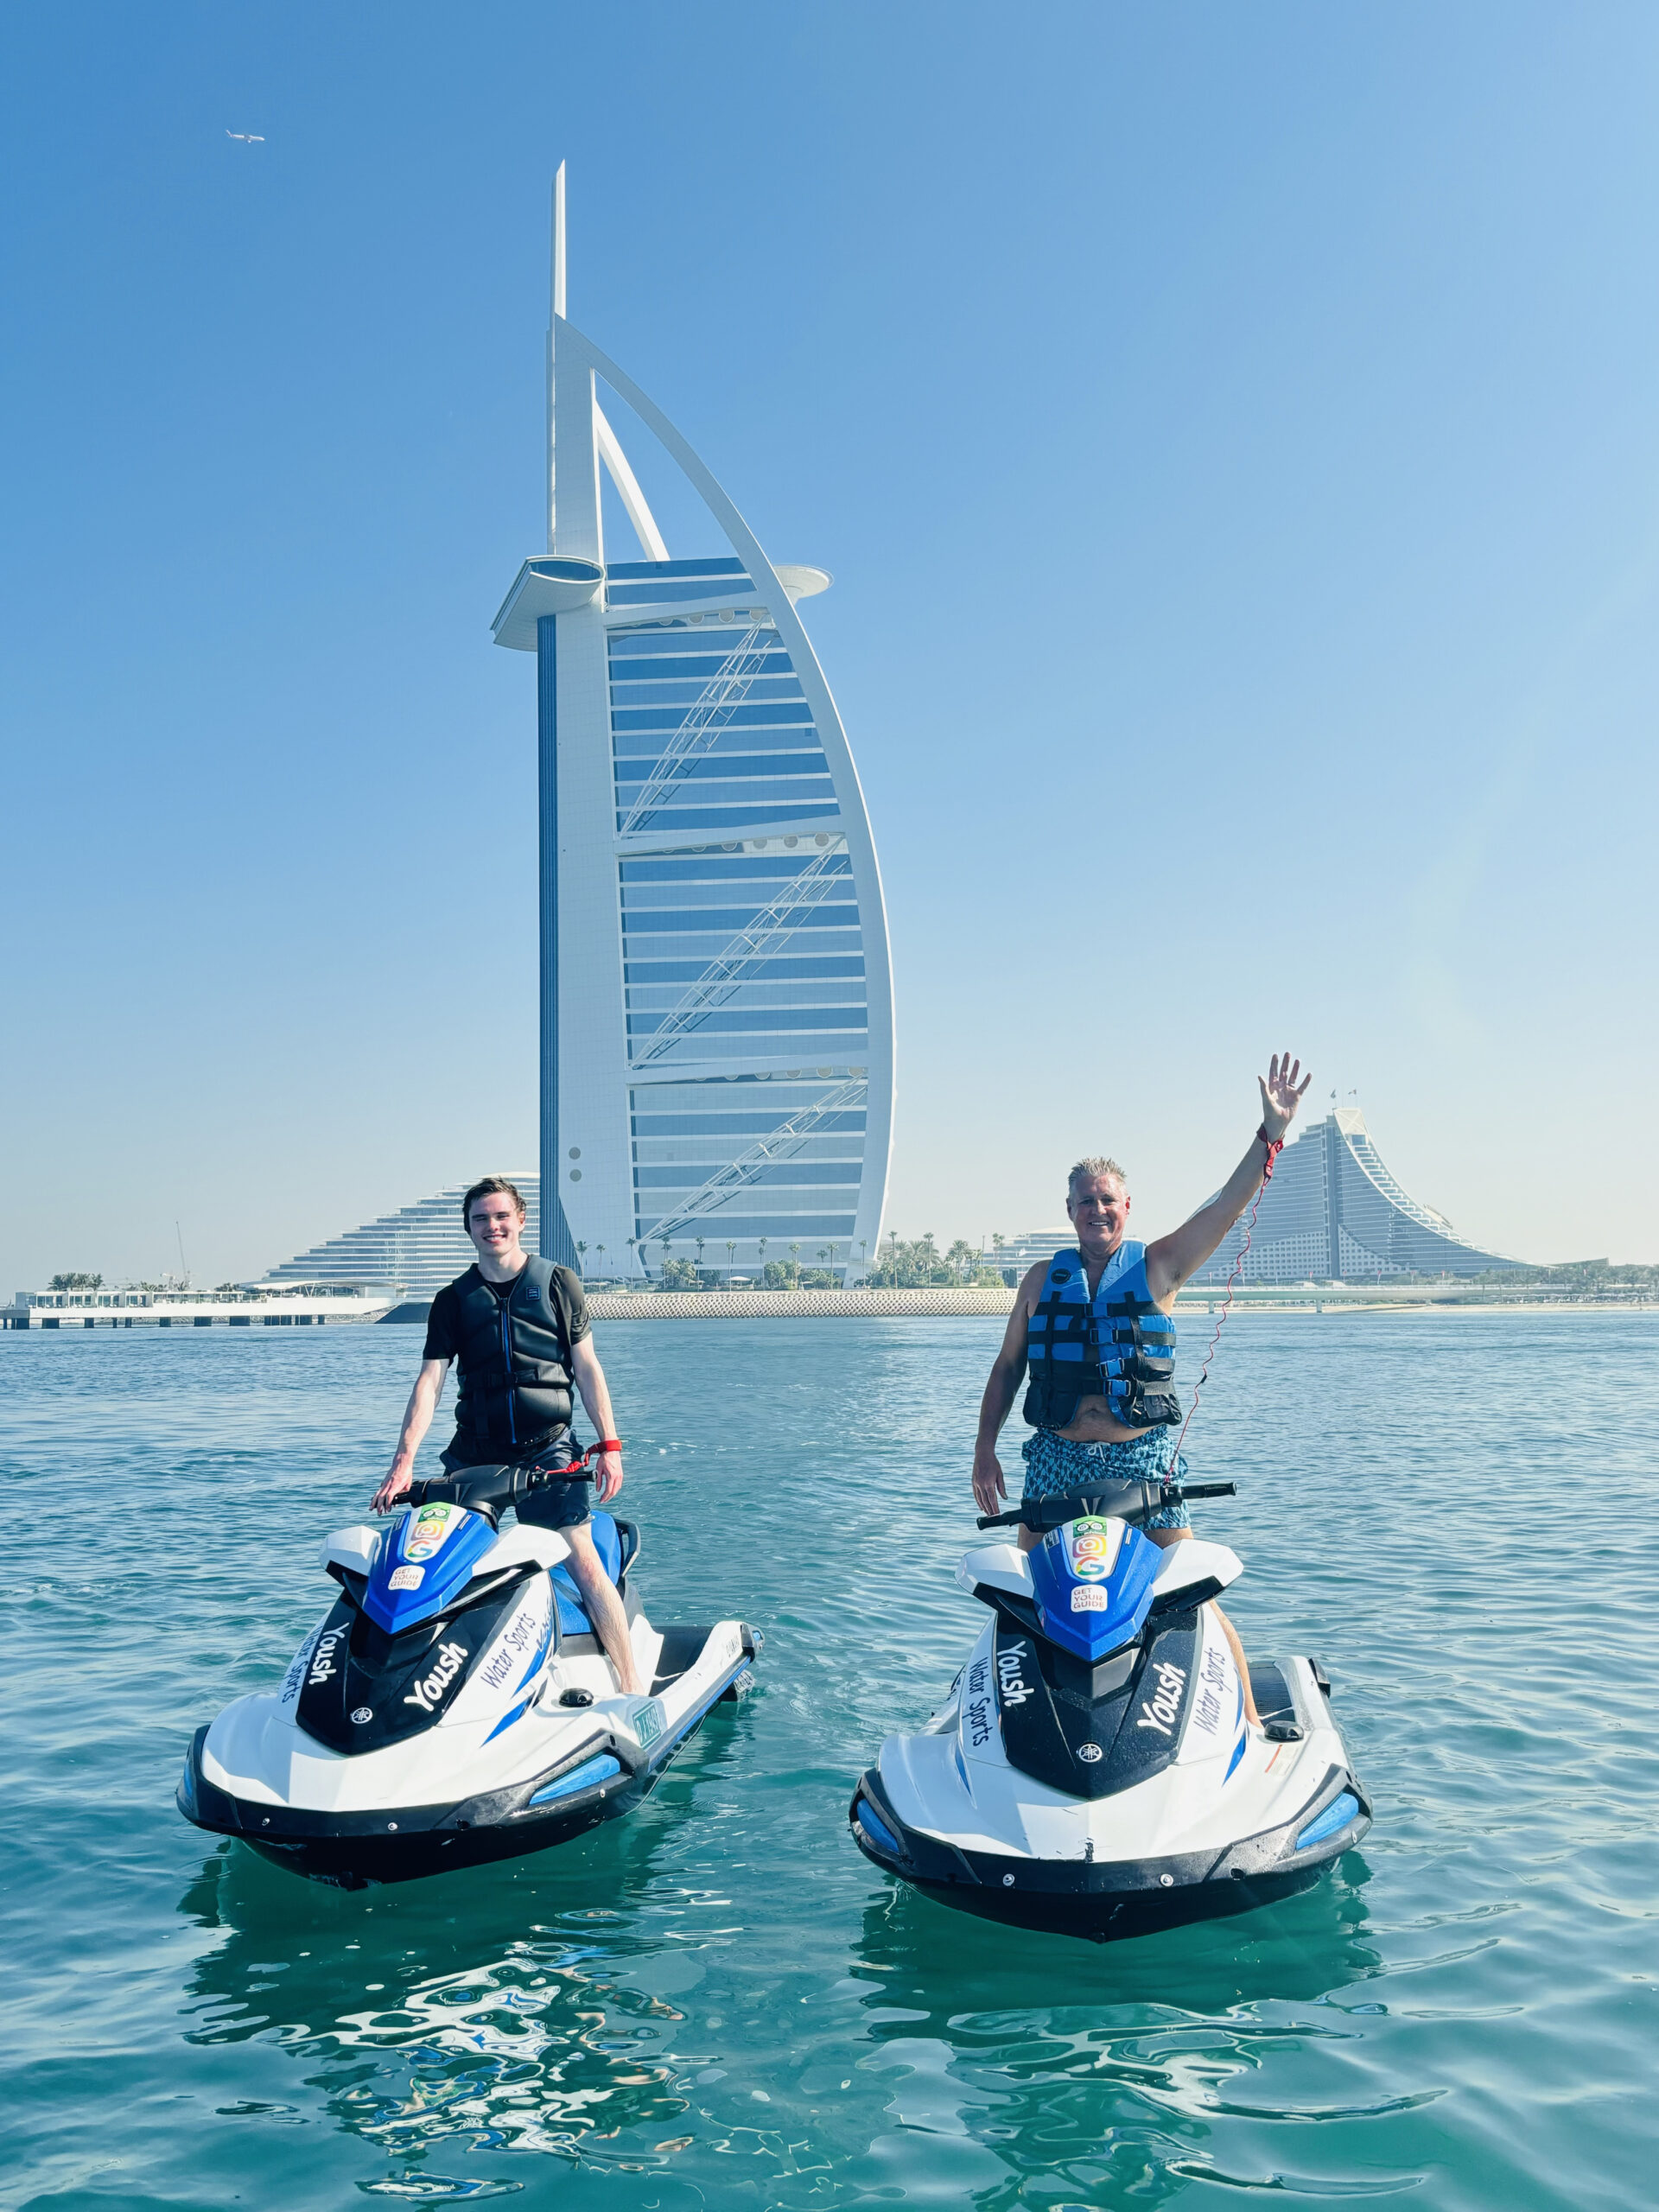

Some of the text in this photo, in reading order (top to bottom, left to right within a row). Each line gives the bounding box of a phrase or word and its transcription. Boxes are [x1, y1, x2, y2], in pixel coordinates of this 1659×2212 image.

[407, 1541, 433, 1558] G
[1077, 1556, 1105, 1575] G
[282, 1661, 309, 1703] Sports
[308, 1622, 350, 1685] Yoush
[404, 1643, 468, 1712] Yoush
[480, 1613, 536, 1689] Water Sports
[996, 1641, 1034, 1707] Yoush
[962, 1656, 993, 1746] Water Sports
[1136, 1662, 1186, 1736] Yoush
[1193, 1647, 1233, 1736] Water Sports
